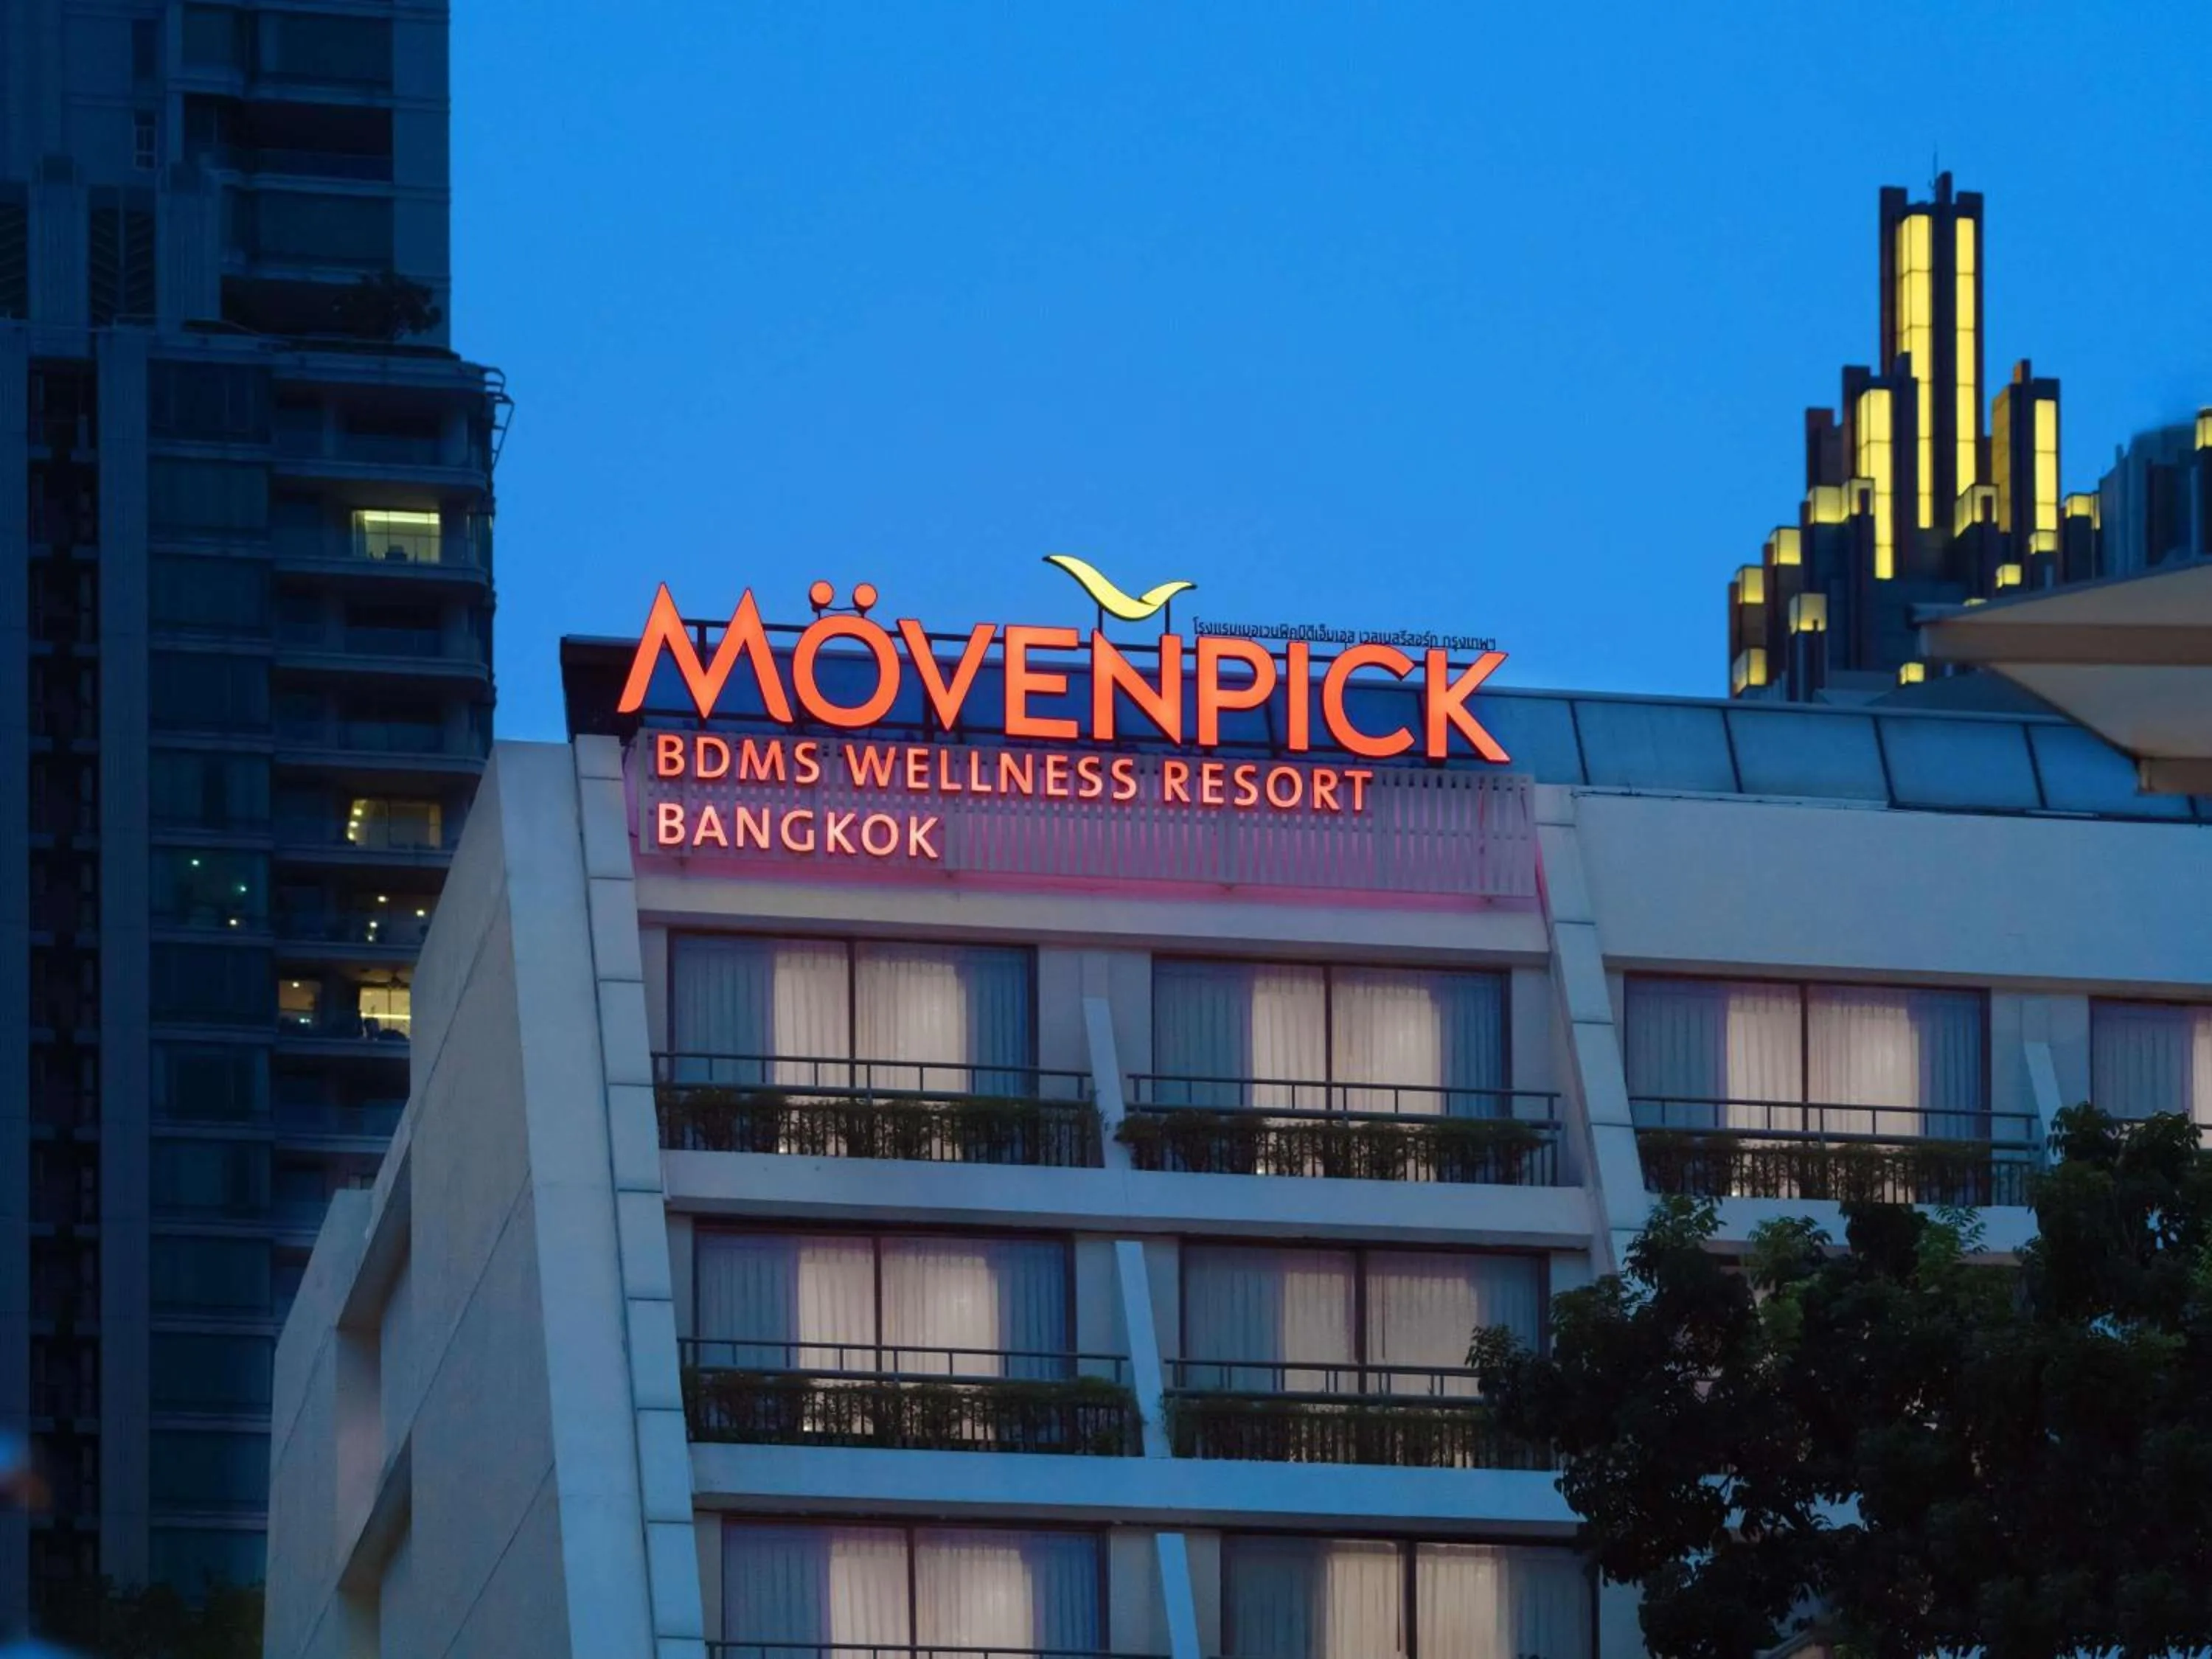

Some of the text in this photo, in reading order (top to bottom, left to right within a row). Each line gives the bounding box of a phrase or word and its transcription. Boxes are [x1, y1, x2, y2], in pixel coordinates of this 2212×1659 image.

[617, 580, 1510, 762] MÖVENPICK
[656, 734, 1373, 812] BDMS WELLNESS RESORT
[656, 801, 940, 859] BANGKOK
